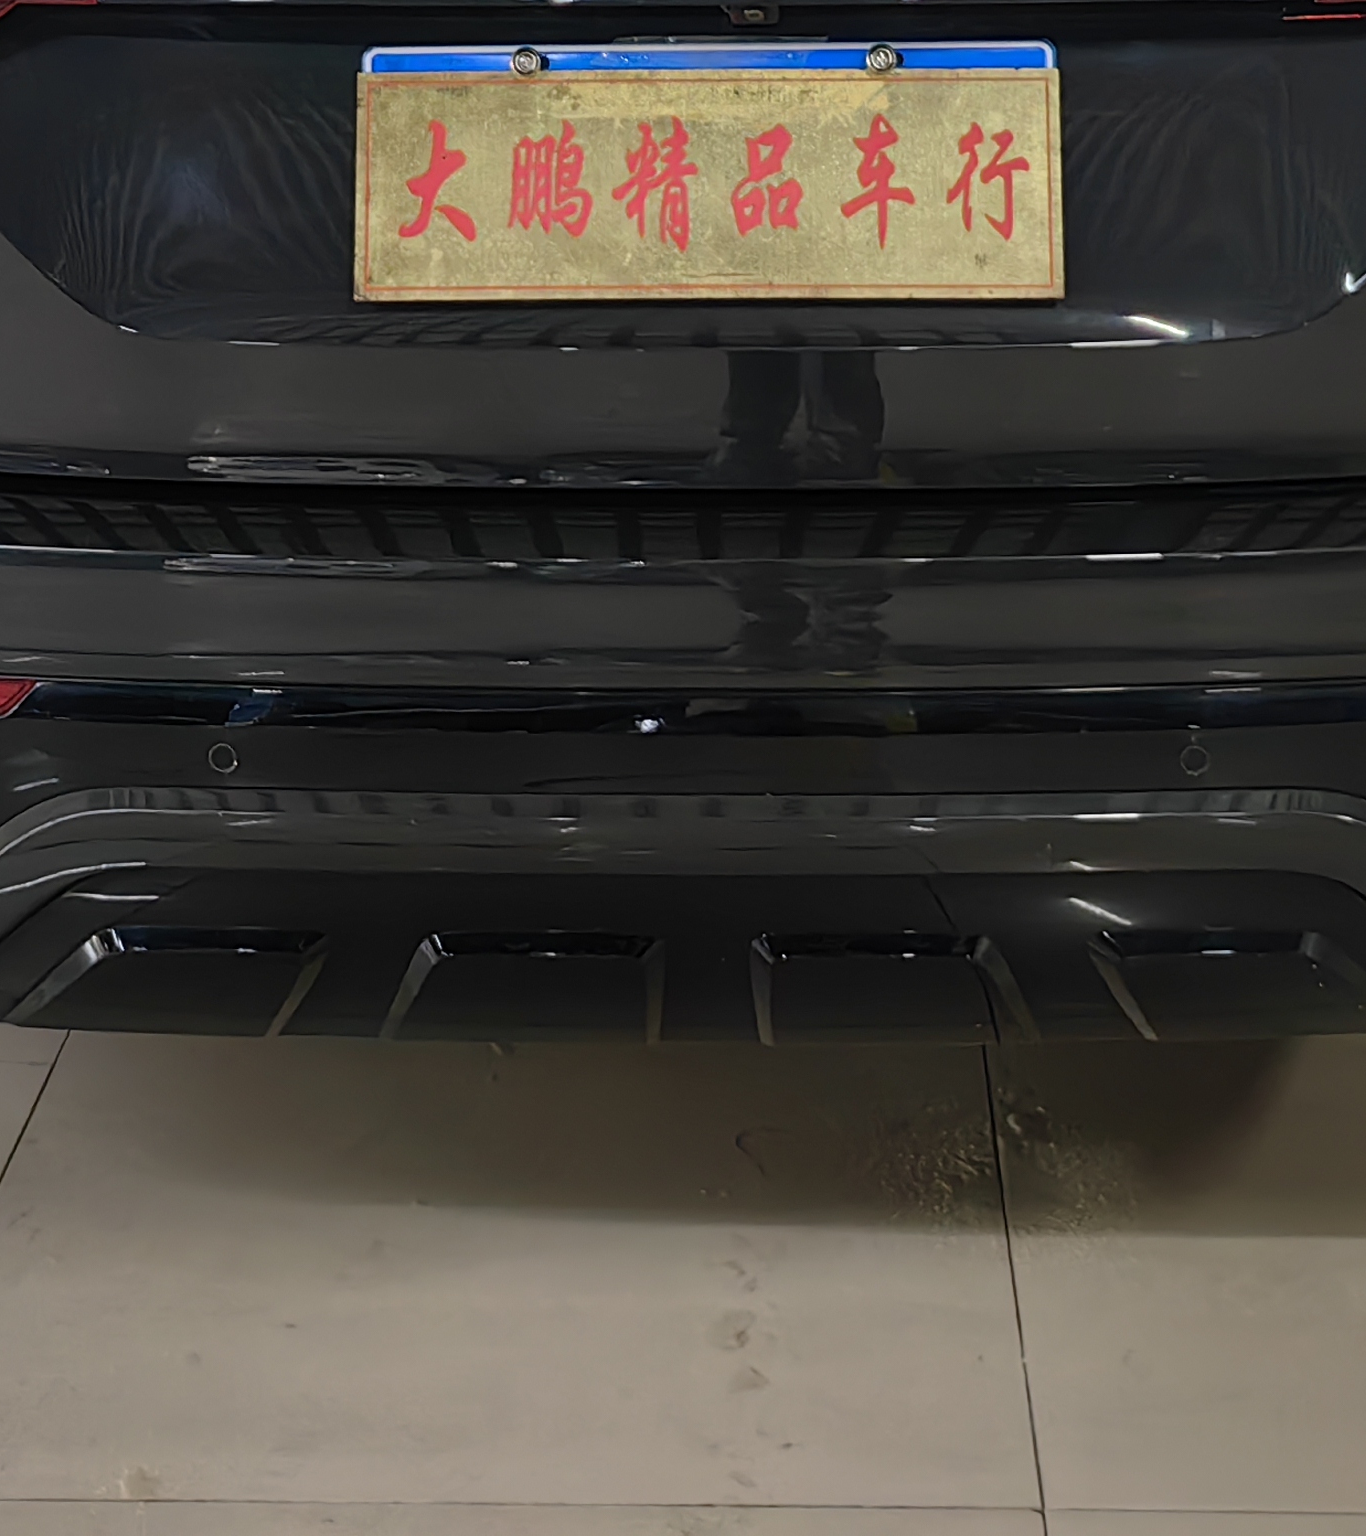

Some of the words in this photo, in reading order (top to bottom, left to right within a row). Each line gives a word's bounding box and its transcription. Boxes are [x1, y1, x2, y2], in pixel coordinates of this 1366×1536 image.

[398, 113, 1030, 252] 大鹏精品车行
